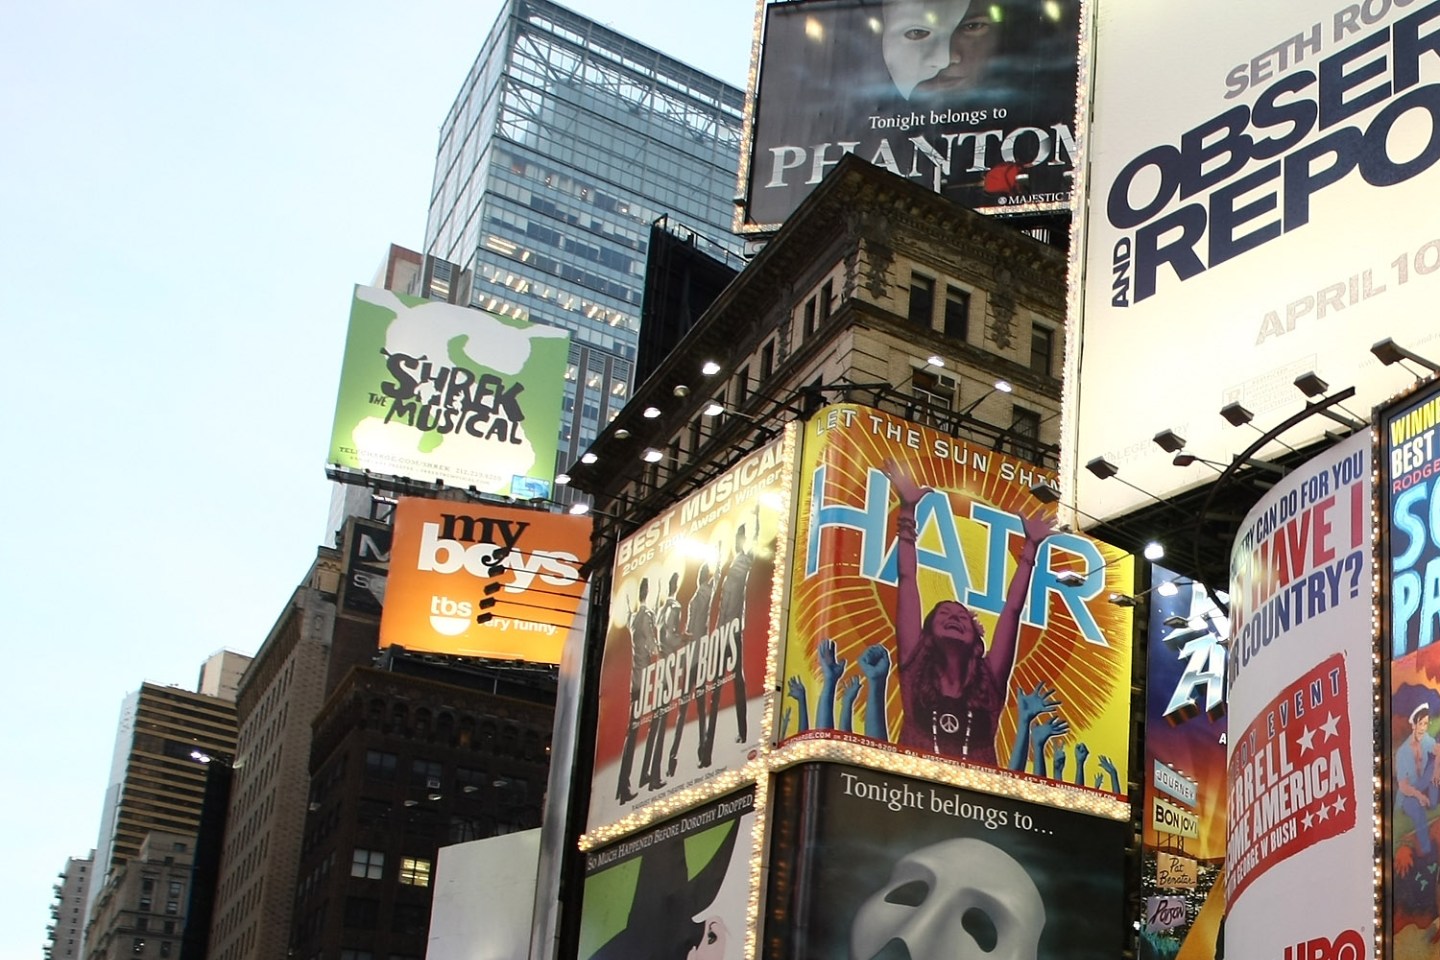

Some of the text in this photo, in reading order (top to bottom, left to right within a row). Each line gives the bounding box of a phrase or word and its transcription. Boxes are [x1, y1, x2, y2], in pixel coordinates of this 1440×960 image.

[1223, 21, 1322, 99] SETH
[869, 107, 1007, 131] Tonight belongs to
[1009, 190, 1063, 205] MAJESTIC
[1111, 236, 1132, 307] AND
[1255, 268, 1386, 346] APRIL
[380, 346, 526, 422] SHREK
[384, 399, 524, 446] MUSICAL
[815, 408, 988, 473] LET THE SUN
[1391, 426, 1436, 480] BEST
[618, 442, 785, 567] BEST MUSICAL
[1257, 449, 1364, 544] CAN DO FOR YOU
[417, 521, 580, 594] boys
[437, 513, 531, 568] my
[622, 548, 655, 576] 2006
[688, 501, 732, 534] Award
[804, 464, 1109, 647] HAIR
[1251, 498, 1336, 614] HAVE
[1350, 480, 1364, 550] I
[430, 595, 473, 617] tbs
[1242, 549, 1364, 668] COUNTRY?
[633, 617, 740, 720] JERSEY BOYS
[1268, 668, 1340, 740] EVENT
[840, 771, 1055, 837] Tonight belongs to...
[1155, 804, 1198, 836] BON JOVI
[1253, 748, 1346, 842] AMERICA
[587, 793, 753, 871] SO MUCH HAPPENED BEFORE DOROTHY DROPPED
[1169, 857, 1184, 874] Pat
[1237, 843, 1260, 885] GEORGE
[1260, 835, 1269, 859] W
[1270, 817, 1297, 853] BUSH
